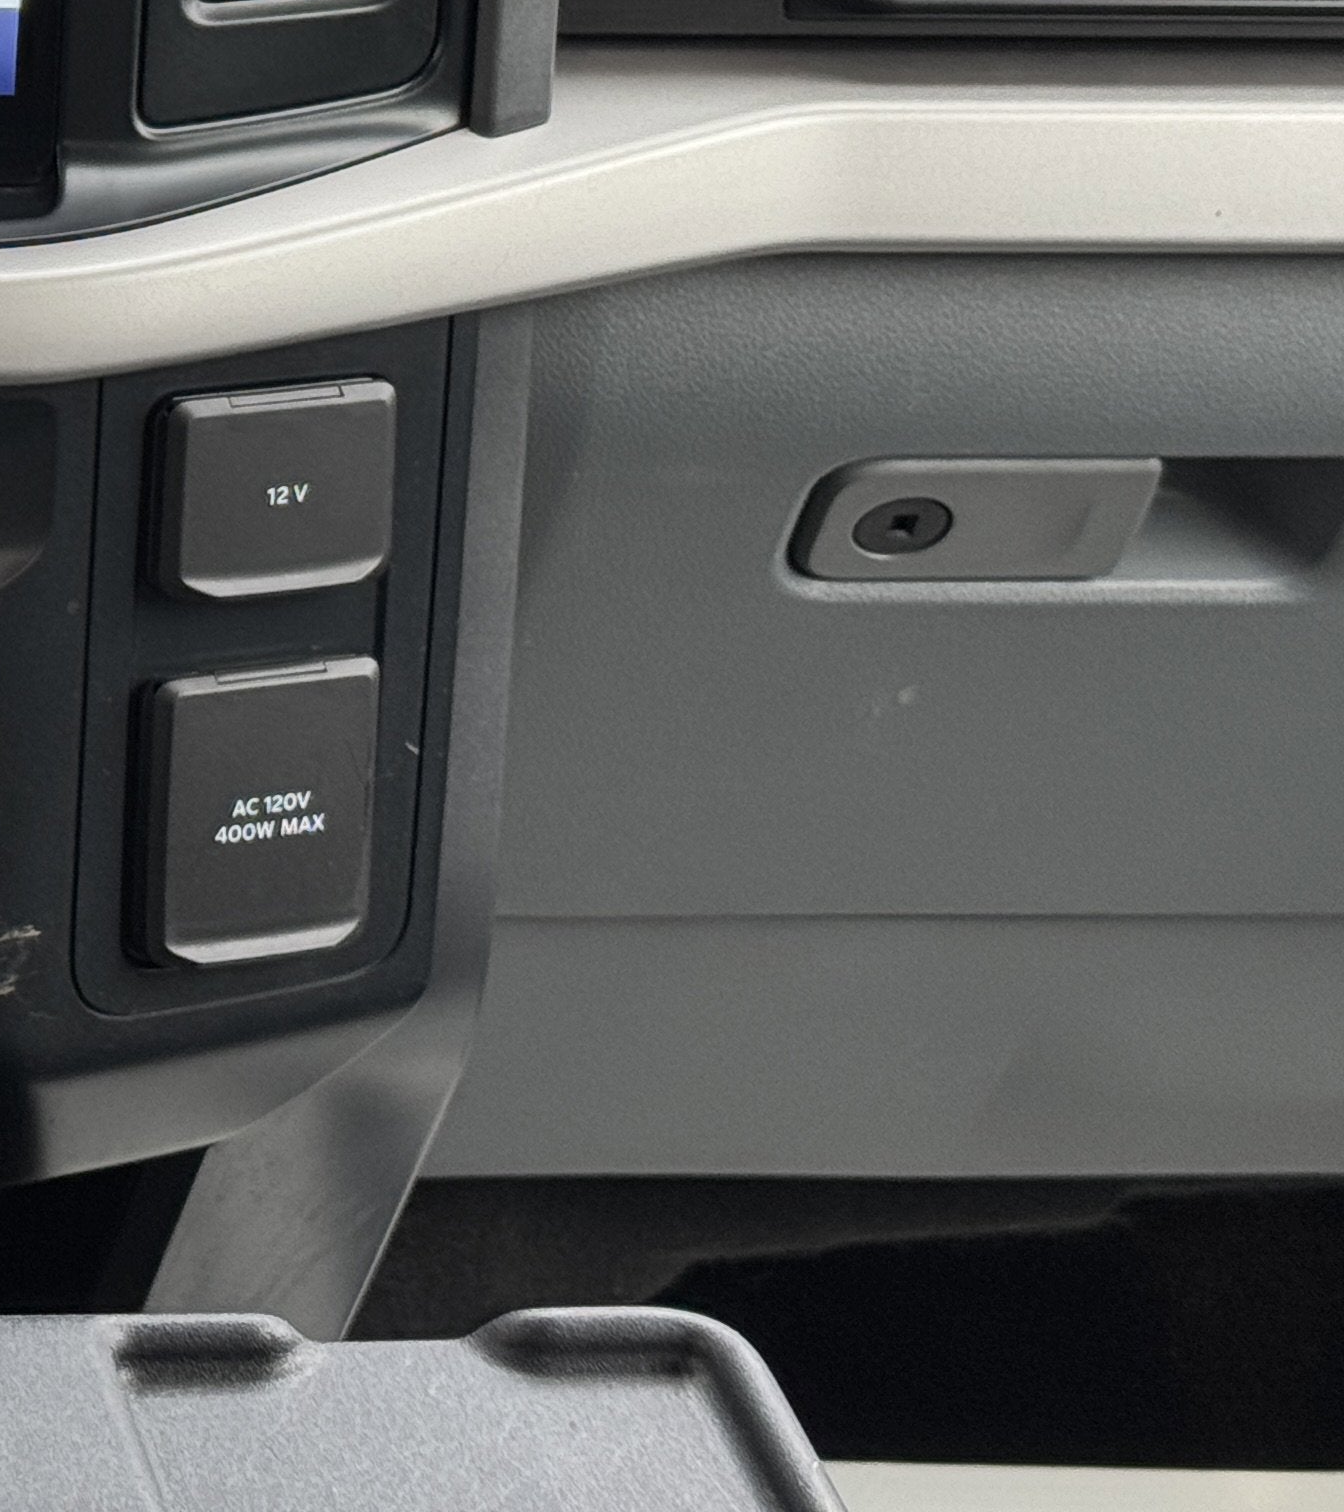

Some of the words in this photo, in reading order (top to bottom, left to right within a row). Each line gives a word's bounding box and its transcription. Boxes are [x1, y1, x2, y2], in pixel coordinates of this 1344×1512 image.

[267, 485, 289, 506] 12
[293, 483, 309, 503] V
[232, 798, 260, 818] AC
[263, 790, 311, 813] 120V
[214, 820, 275, 844] 400W
[280, 813, 325, 836] MAX
